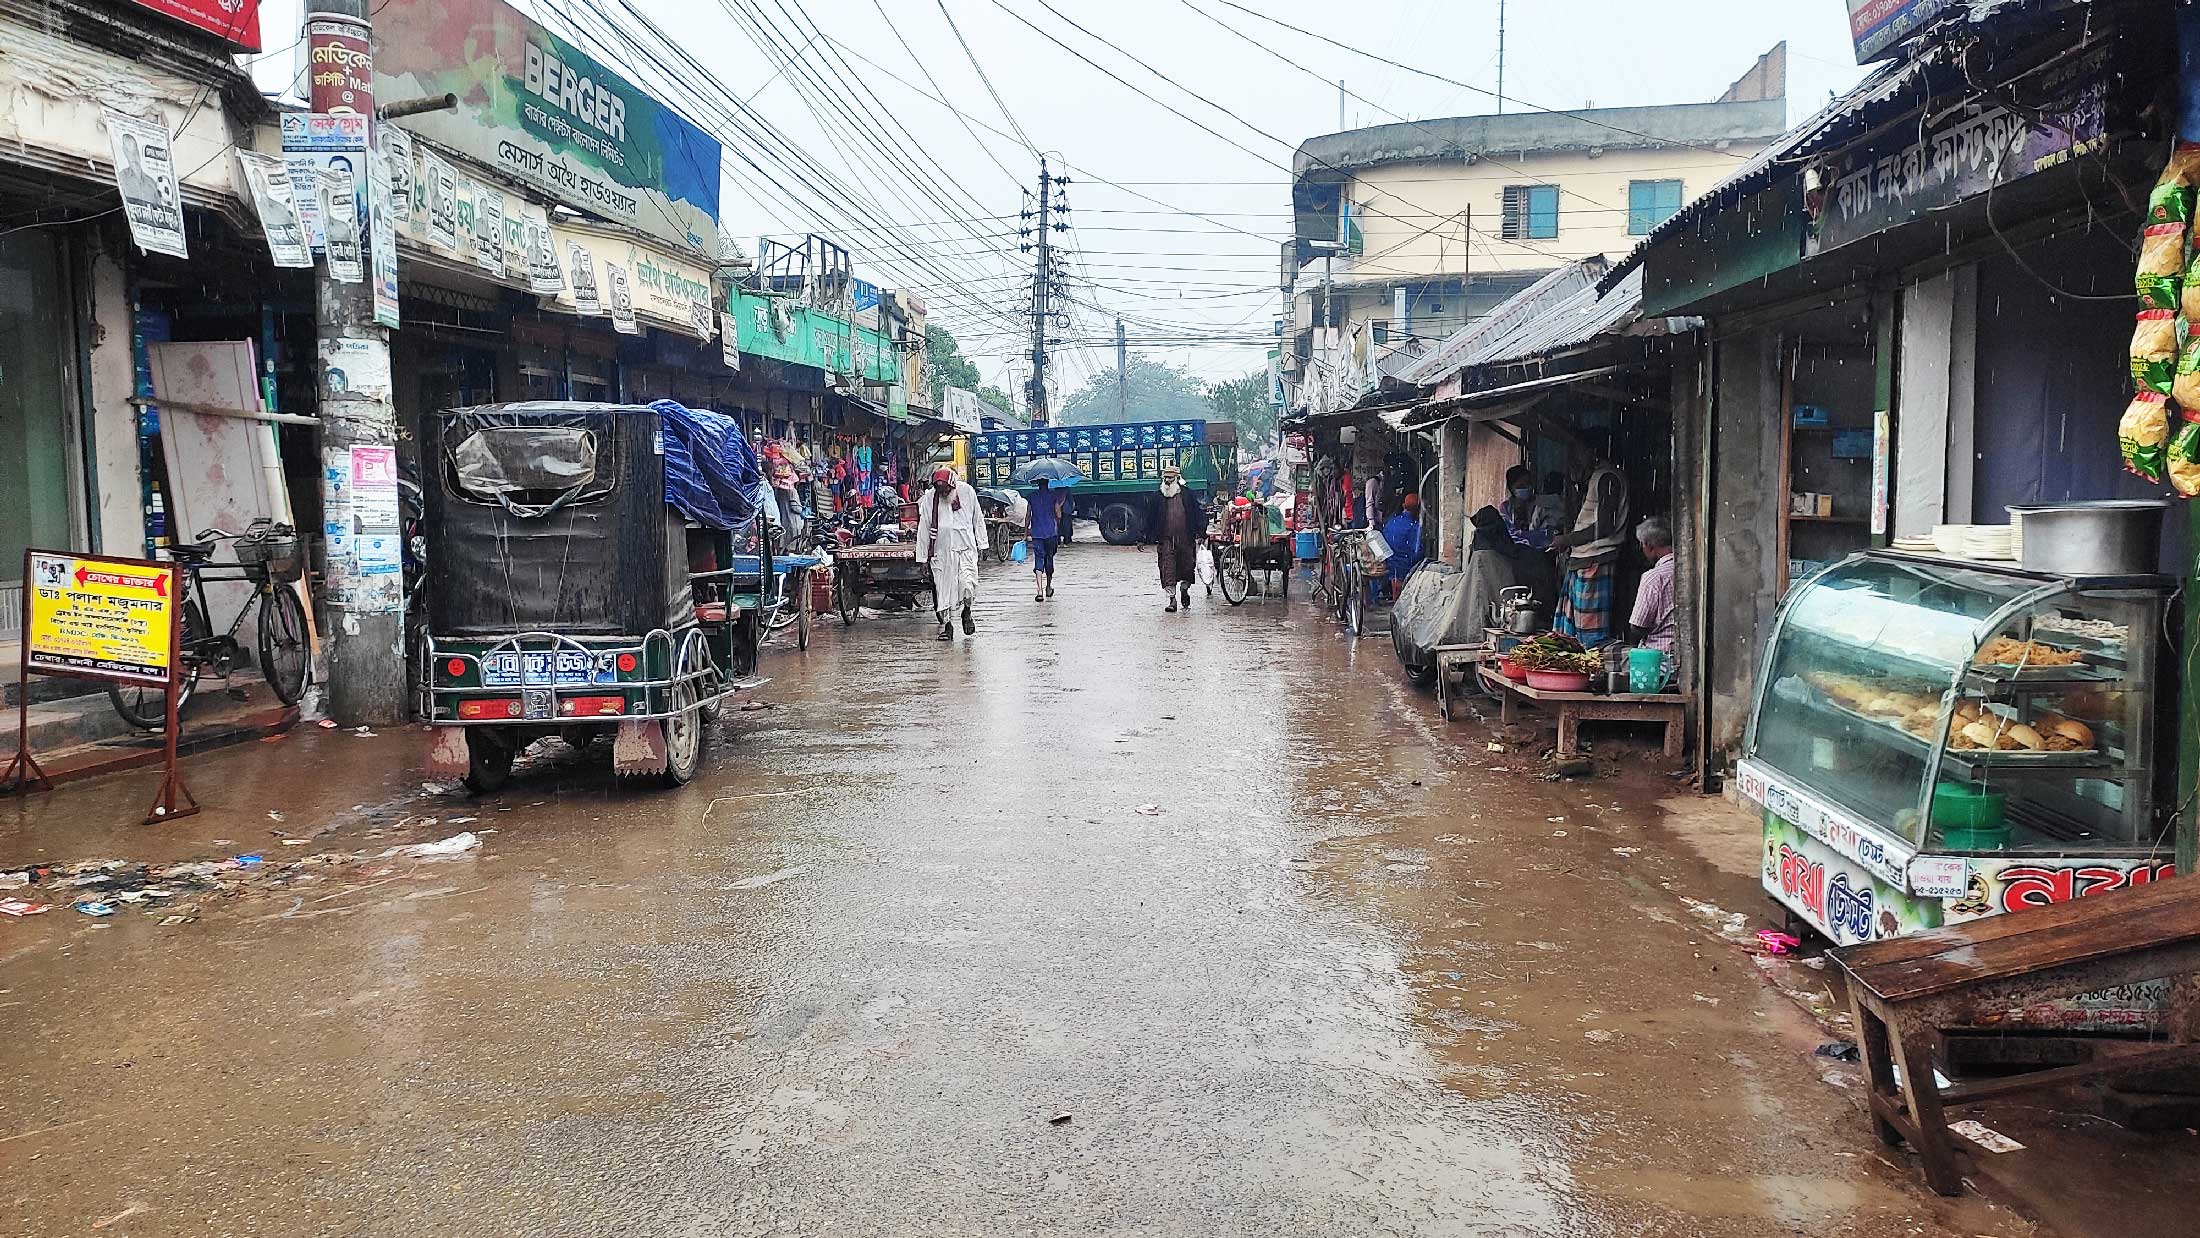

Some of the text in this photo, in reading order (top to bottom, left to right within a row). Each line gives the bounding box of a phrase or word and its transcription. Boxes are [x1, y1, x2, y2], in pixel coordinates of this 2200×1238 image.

[314, 72, 373, 94] ভার্সিটি Mat
[524, 41, 625, 141] BERGER
[524, 103, 547, 129] বার্জার
[572, 127, 600, 157] বাংলাদেশ
[600, 139, 624, 167] লিমিটেড
[498, 140, 544, 175] মেসার্স
[548, 157, 577, 190] অথৈ
[580, 175, 637, 216] হার্ডওয়্যার
[39, 588, 163, 611] ডাঃ পলাশ মজুমদার
[87, 572, 154, 588] চোখের ডাক্তার
[1780, 844, 1873, 943] নয়া টেস্ট
